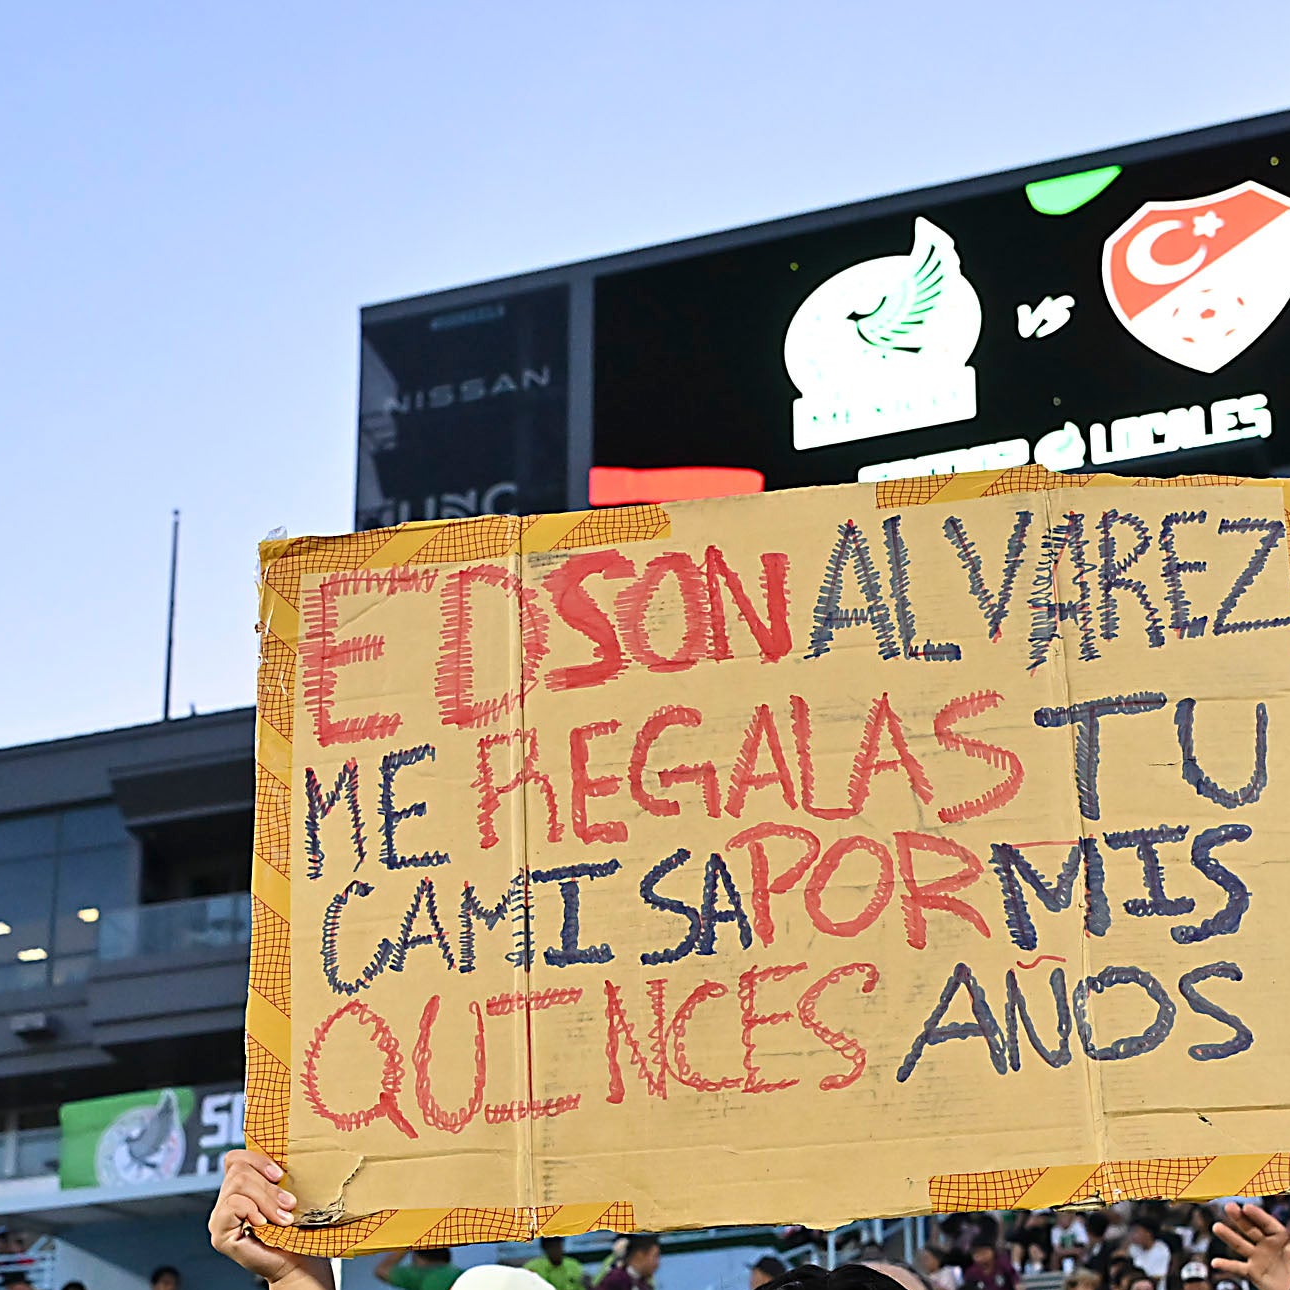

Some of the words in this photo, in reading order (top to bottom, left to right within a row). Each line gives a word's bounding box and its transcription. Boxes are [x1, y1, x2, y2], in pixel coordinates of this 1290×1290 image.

[384, 365, 551, 414] NISSAN
[1018, 295, 1076, 339] VS
[300, 545, 792, 745] EDSON
[305, 743, 451, 879] ME
[469, 690, 1025, 848] REGALAS
[1034, 691, 1269, 822] TU
[320, 850, 753, 996] CAMISA
[726, 821, 991, 949] POR
[989, 822, 1252, 951] MIS
[301, 961, 879, 1139] QUINCES
[897, 955, 1255, 1082] AÑOS
